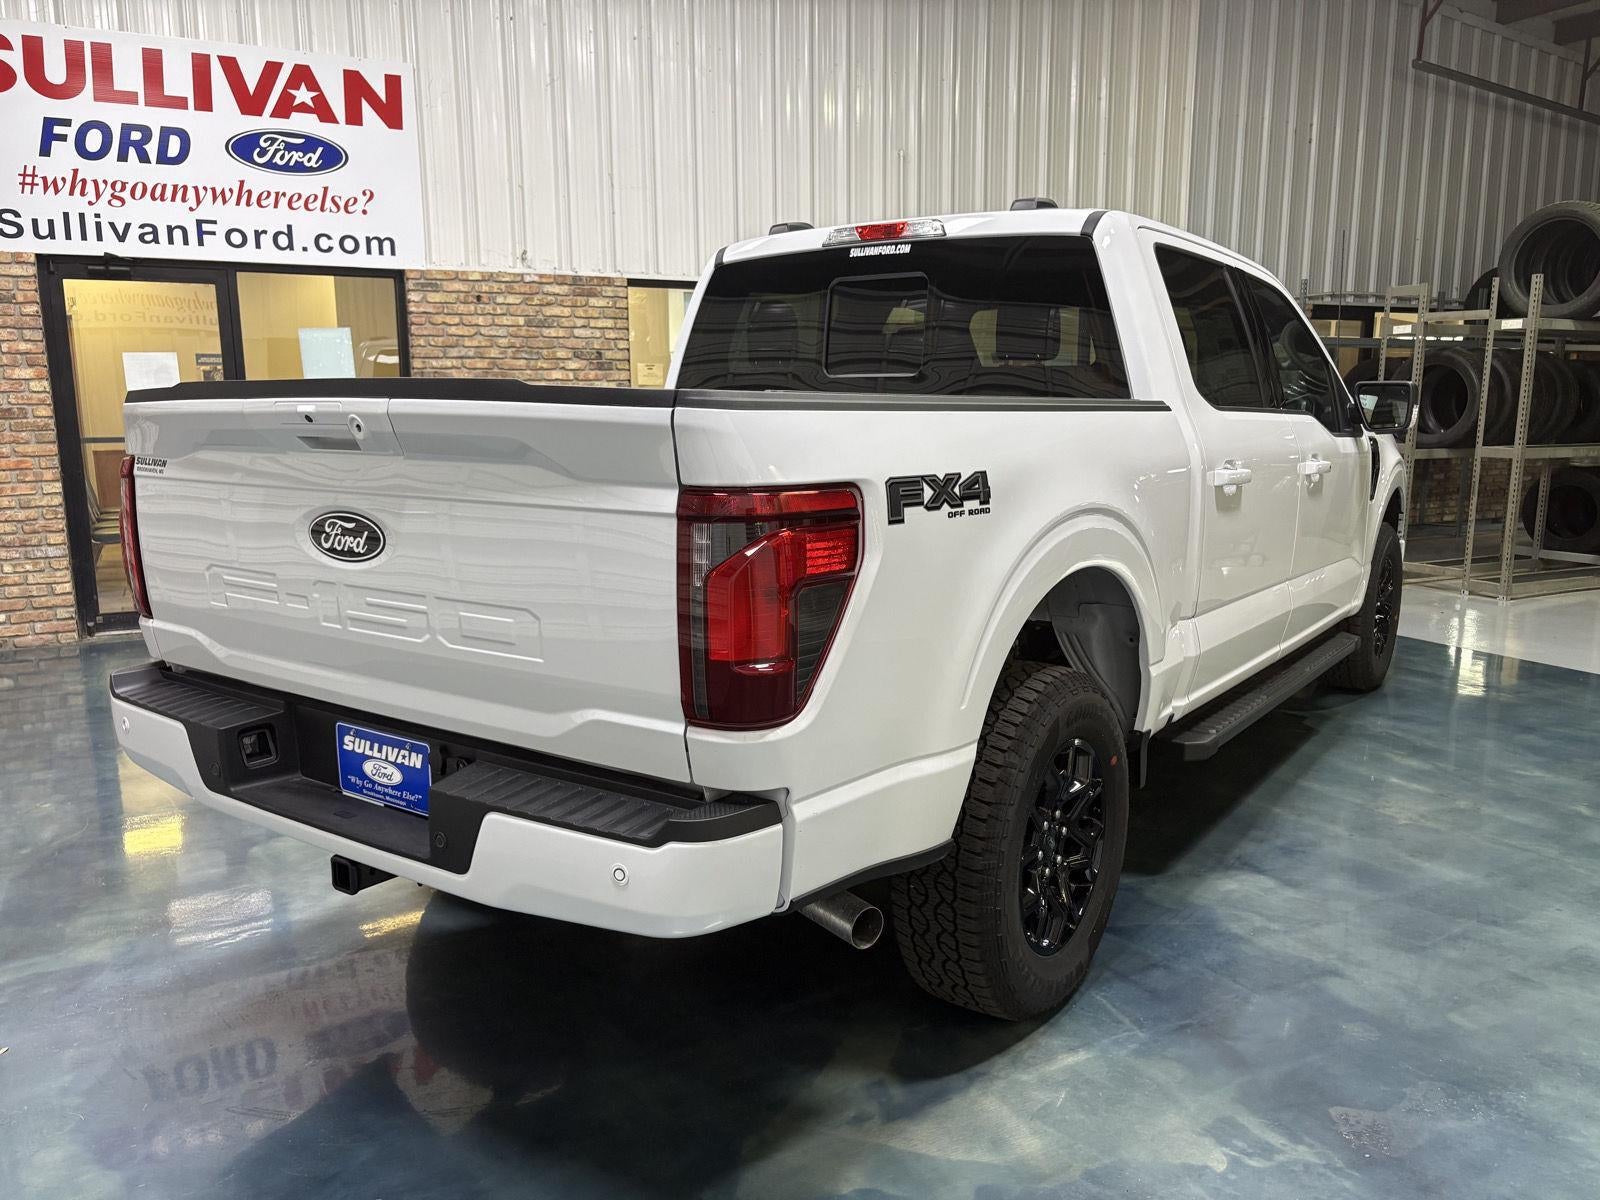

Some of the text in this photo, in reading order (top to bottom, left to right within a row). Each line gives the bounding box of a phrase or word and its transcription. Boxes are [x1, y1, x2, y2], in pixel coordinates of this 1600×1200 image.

[38, 116, 191, 166] FORD
[252, 133, 324, 168] Ford
[18, 165, 375, 216] #whygoanywhereelse?
[0, 208, 397, 256] SullivanFord.com
[849, 244, 912, 258] SULLIVANFORD.COM
[136, 456, 168, 468] SULLIVAN
[885, 470, 991, 526] FX4
[947, 507, 991, 519] OFF ROAD
[320, 518, 368, 554] Ford
[205, 563, 544, 662] F-150
[343, 735, 423, 769] SULLIVAN
[363, 780, 373, 789] Go
[373, 783, 401, 797] Anywhere
[370, 763, 394, 782] Ford
